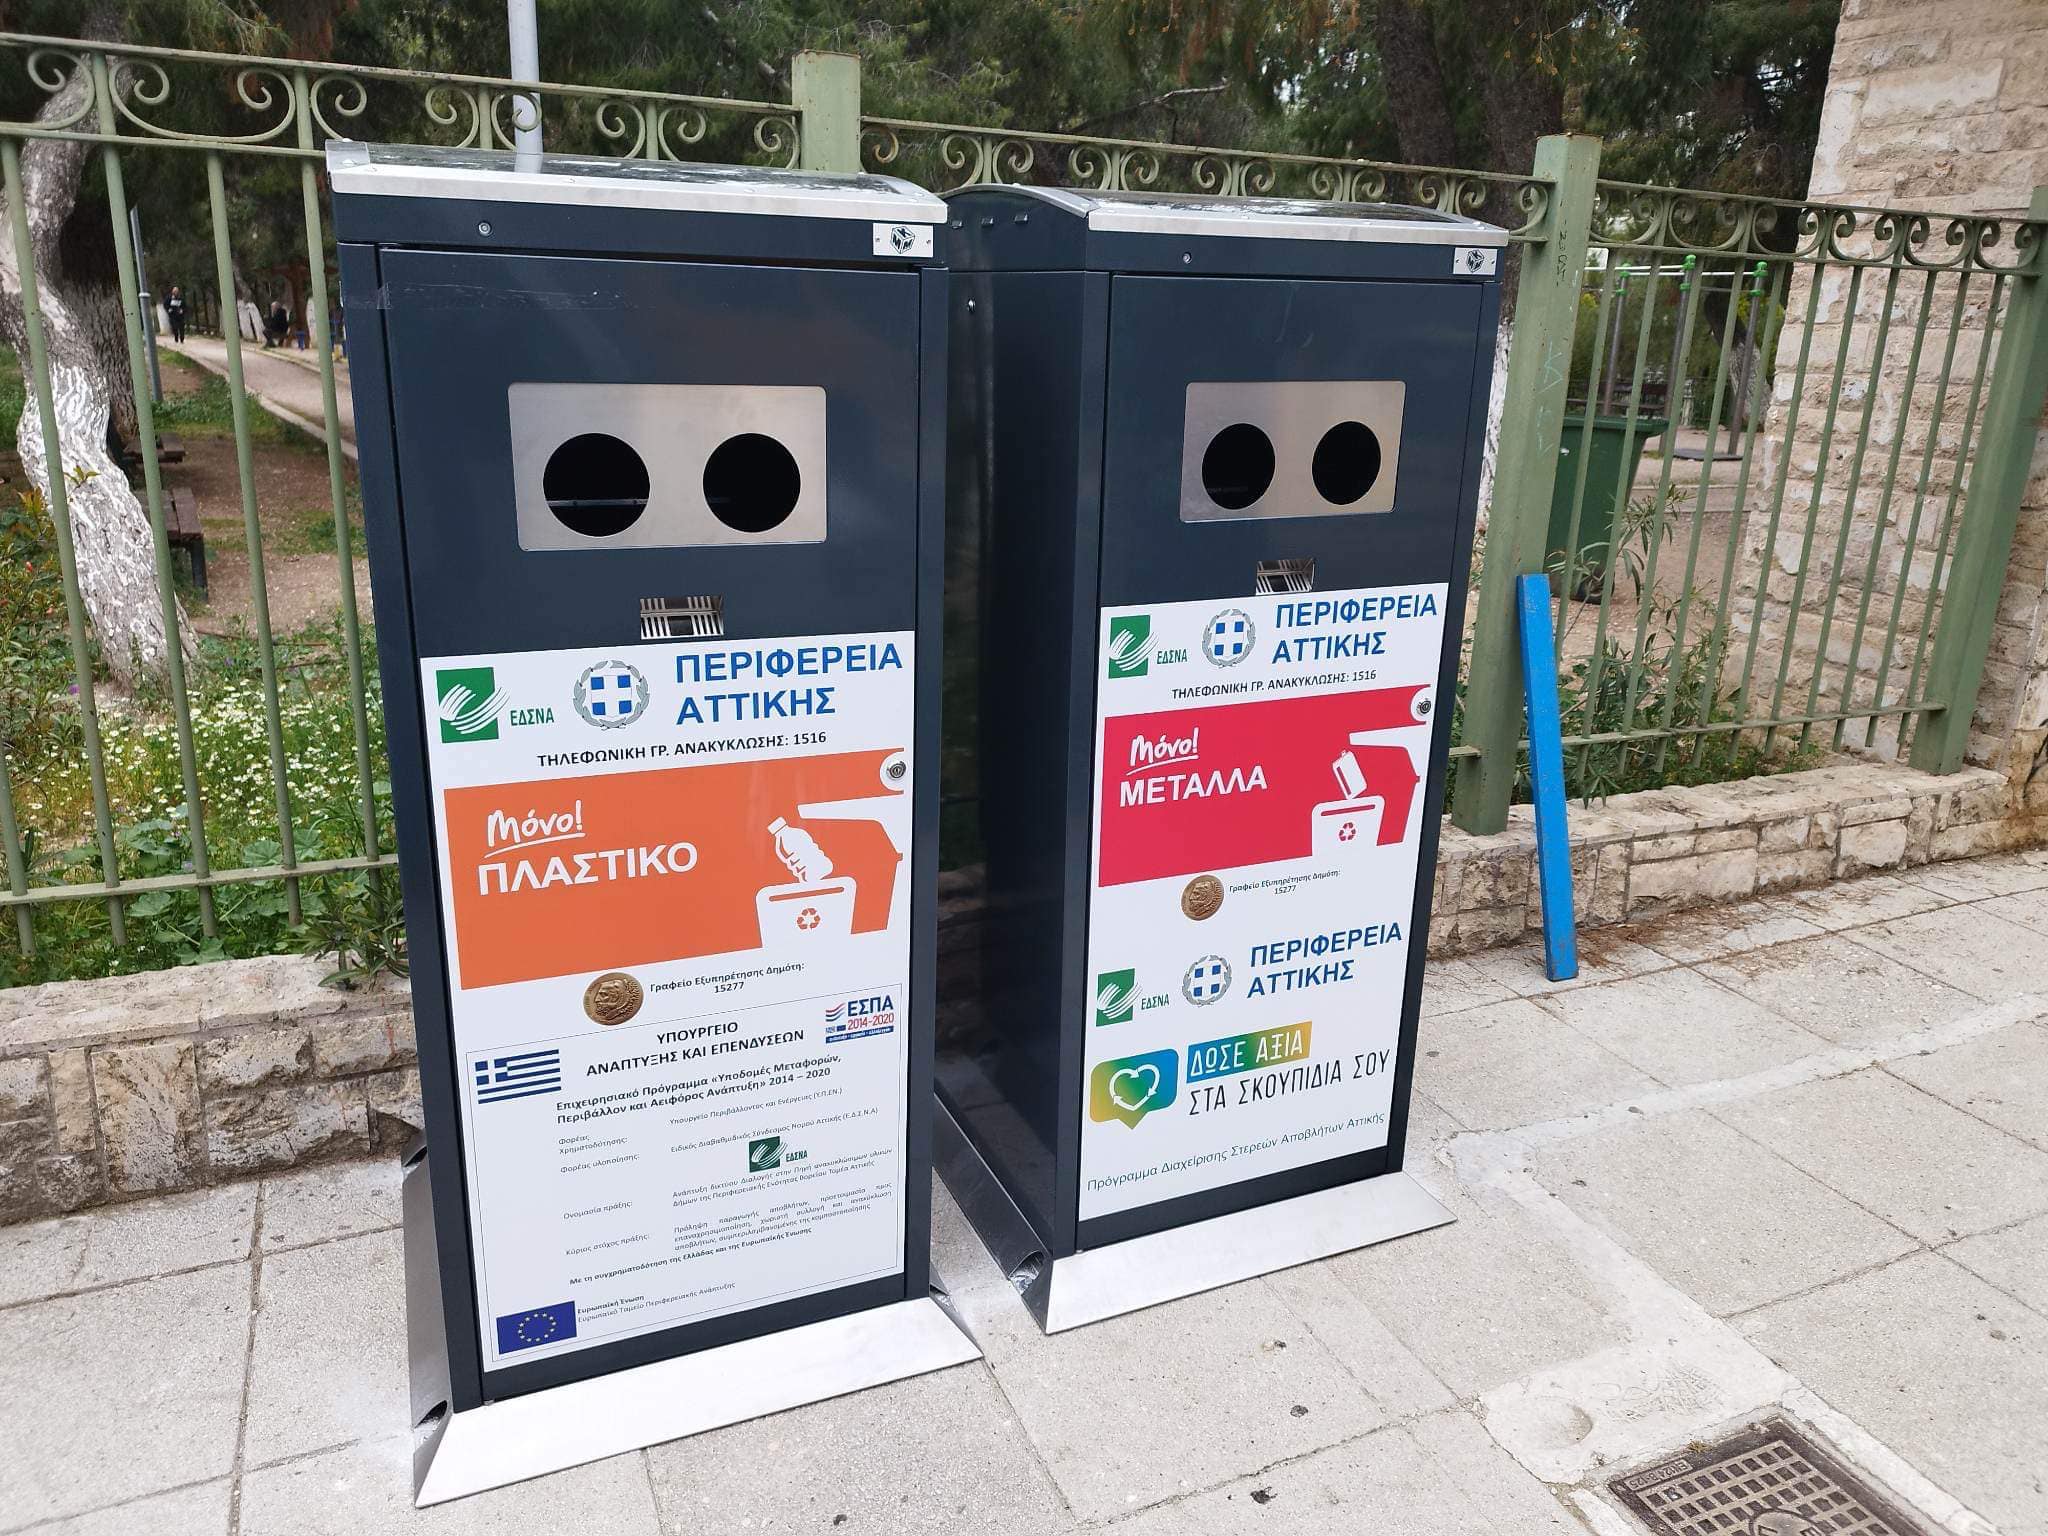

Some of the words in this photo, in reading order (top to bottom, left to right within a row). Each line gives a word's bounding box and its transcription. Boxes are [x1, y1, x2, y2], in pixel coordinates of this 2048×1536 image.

[1275, 593, 1438, 628] ΠΕΡΙΦΕΡΕΙΑ
[676, 643, 903, 684] ΠΕΡΙΦΕΡΕΙΑ
[1156, 648, 1188, 665] ΕΔΣΝΑ
[1271, 631, 1387, 664] ΑΤΤΙΚΗΣ
[1172, 681, 1248, 700] ΤΗΛΕΦΩΝΙΚΗ
[1251, 679, 1265, 693] ΓΡ.
[1267, 672, 1350, 691] ΑΝΑΚΥΚΛΩΣΗΣ:
[1352, 669, 1377, 682] 1516
[510, 707, 555, 727] ΕΔΣΝΑ
[676, 687, 836, 725] ΑΤΤΙΚΗΣ
[537, 745, 645, 768] ΤΗΛΕΦΩΝΙΚΗ
[650, 743, 669, 760] ΓΡ.
[674, 736, 789, 757] ΑΝΑΚΥΚΛΩΣΗΣ:
[793, 731, 827, 746] 1516
[1130, 727, 1199, 767] Μόνο!
[1119, 765, 1268, 808] ΜΕΤΑΛΛΑ
[487, 799, 582, 848] Μόνο!
[478, 841, 699, 896] ΠΛΑΣΤΙΚΟ
[1273, 884, 1297, 895] 15277
[1250, 921, 1403, 967] ΠΕΡΙΦΕΡΕΙΑ
[650, 979, 693, 993] Γραφείο
[695, 968, 764, 986] Εξυπηρέτησης
[766, 961, 805, 975] Δημότη:
[714, 981, 745, 994] 15277
[1247, 959, 1355, 999] ΑΤΤΙΚΗΣ
[847, 994, 894, 1017] ΕΣΠΑ
[1141, 993, 1170, 1011] ΕΔΣΝΑ
[657, 1021, 739, 1044] ΥΠΟΥΡΓΕΙΟ
[847, 1012, 895, 1031] 2014-2020
[586, 1048, 678, 1077] ΑΝΑΠΤΥΞΗΣ
[682, 1044, 707, 1061] ΚΑΙ
[711, 1029, 805, 1056] ΕΠΕΝΔΥΣΕΩΝ
[1190, 1040, 1246, 1077] ΔΩΣΕ
[1255, 1029, 1304, 1063] ΑΞΙΑ
[556, 1087, 640, 1112] Επιχειρησιακό
[643, 1075, 709, 1098] Πρόγραμμα
[557, 1102, 627, 1124] Περιβάλλον
[629, 1100, 648, 1111] και
[650, 1088, 705, 1108] Αειφόρος
[769, 1074, 794, 1086] 2014
[805, 1067, 831, 1080] 2020
[1189, 1084, 1226, 1116] ΣΤΑ
[1238, 1059, 1342, 1105] ΣΚΟΥΠΙΔΙΑ
[1353, 1049, 1390, 1079] ΣΟΥ
[785, 1149, 808, 1163] ΕΔΣΝΑ
[1087, 1164, 1158, 1192] Πρόγραμμα
[1161, 1149, 1229, 1175] Διαχείρισης
[1230, 1137, 1278, 1158] Στερεών
[1280, 1122, 1344, 1146] Αποβλήτων
[1346, 1111, 1385, 1131] Αττικής
